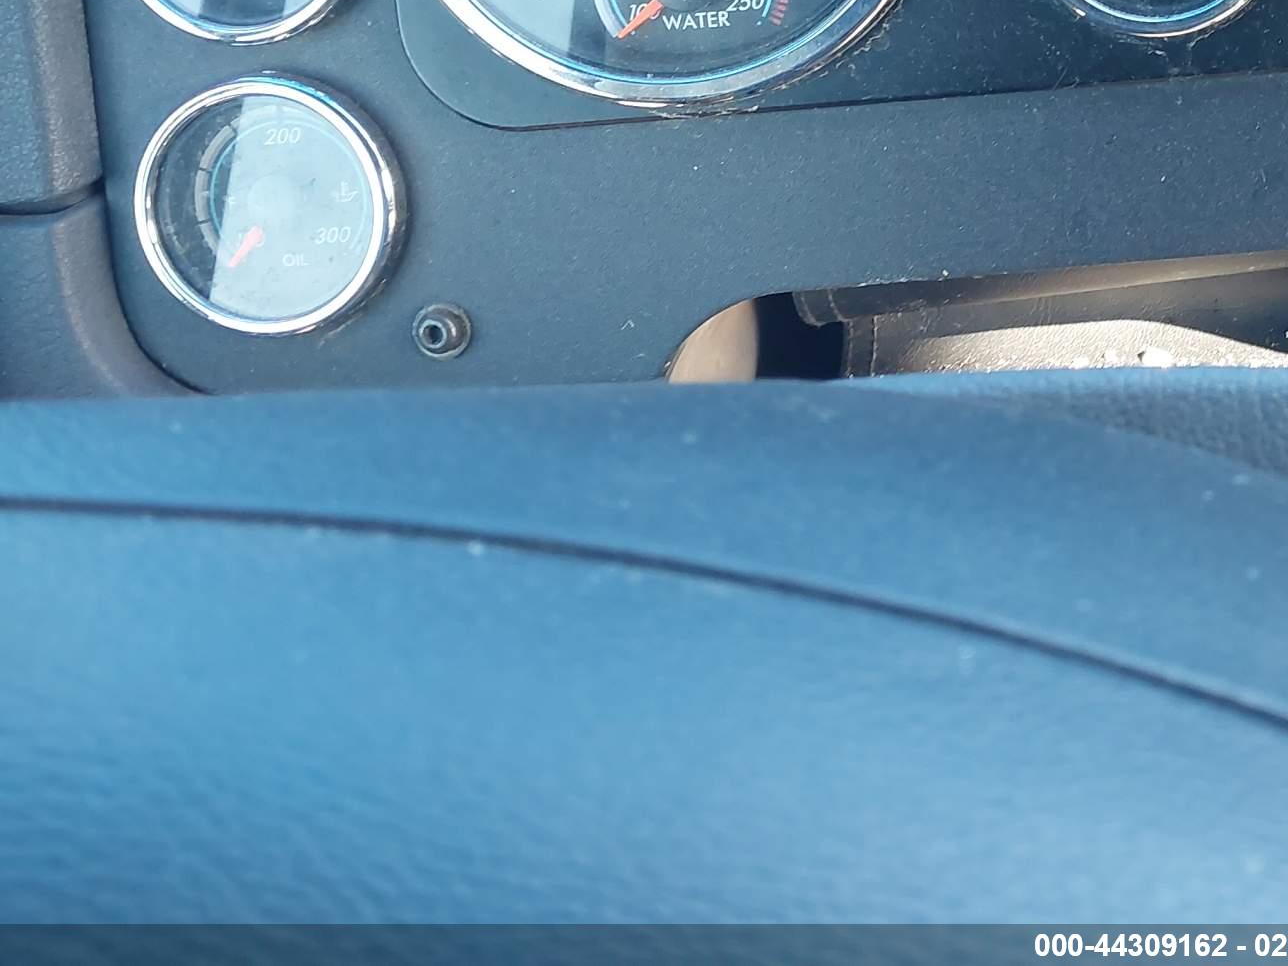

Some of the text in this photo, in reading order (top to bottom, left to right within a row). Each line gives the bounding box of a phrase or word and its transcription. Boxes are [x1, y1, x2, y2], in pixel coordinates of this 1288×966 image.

[663, 11, 730, 30] WATER
[264, 127, 300, 145] 200
[315, 226, 351, 245] 300
[283, 253, 311, 266] OIL
